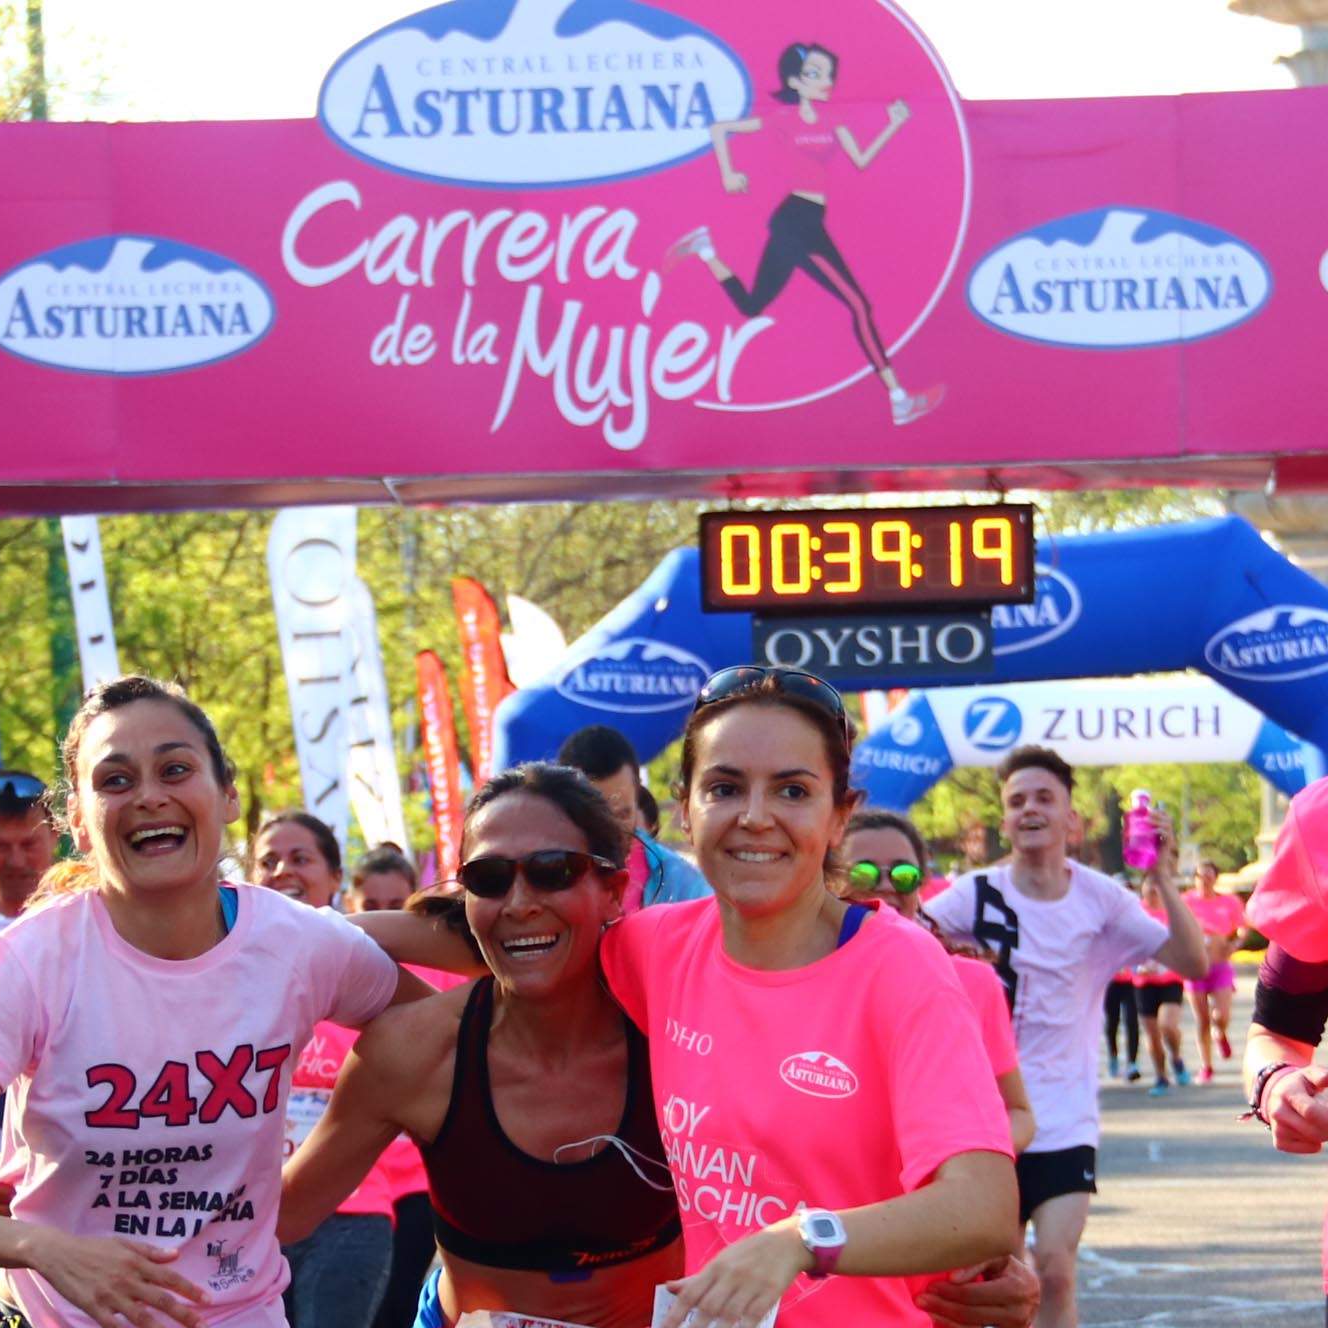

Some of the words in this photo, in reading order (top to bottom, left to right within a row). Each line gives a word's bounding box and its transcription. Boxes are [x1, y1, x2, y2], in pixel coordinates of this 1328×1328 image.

[417, 55, 552, 77] CENTRAL
[568, 51, 705, 74] LECHERA
[350, 64, 718, 140] ASTURIANA
[280, 181, 641, 287] Carrera
[988, 261, 1250, 316] ASTURIANA
[3, 287, 253, 341] ASTURIANA
[371, 293, 438, 367] de
[451, 295, 501, 366] la
[490, 270, 776, 450] Mujer
[720, 518, 1015, 597] 00:39:19
[765, 620, 986, 671] OYSHO
[1042, 704, 1221, 741] ZURICH
[858, 749, 940, 776] ZURICH
[84, 1043, 292, 1130] 24X7
[786, 1062, 852, 1092] ASTURIANA
[84, 1150, 116, 1168] 24
[122, 1143, 214, 1167] HORAS
[99, 1175, 114, 1189] 7
[119, 1165, 179, 1186] DÍAS
[91, 1192, 111, 1209] A
[117, 1190, 152, 1210] LA
[113, 1213, 150, 1236] EN
[155, 1216, 187, 1237] LA
